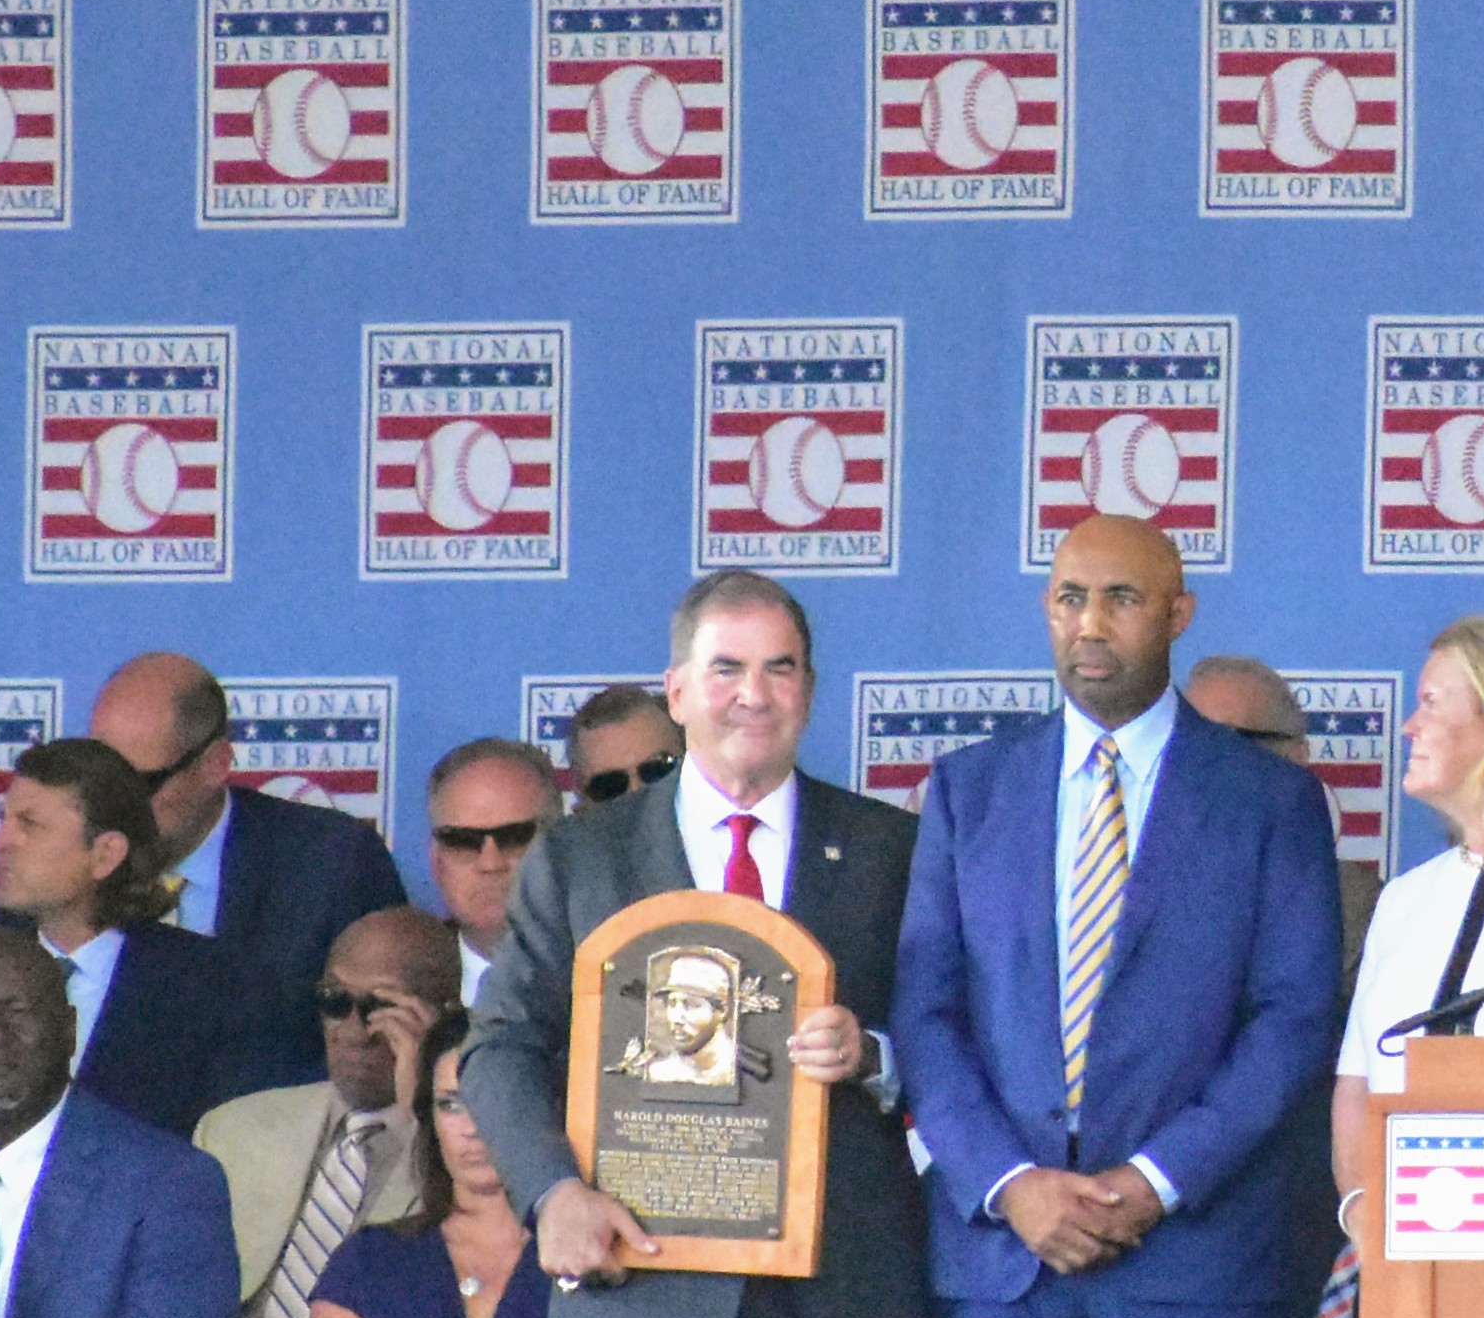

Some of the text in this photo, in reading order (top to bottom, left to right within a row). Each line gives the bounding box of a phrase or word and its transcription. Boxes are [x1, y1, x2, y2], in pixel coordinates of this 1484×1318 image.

[214, 38, 390, 62] BASEBALL
[548, 34, 723, 58] BASEBALL
[882, 27, 1058, 53] BASEBALL
[1218, 28, 1397, 49] BASEBALL
[212, 186, 390, 210] HALL OF FAME
[546, 182, 724, 206] HALL OF FAME
[880, 177, 1057, 201] HALL OF FAME
[1216, 177, 1397, 198] HALL OF FAME
[44, 341, 219, 363] NATIONAL
[378, 337, 553, 361] NATIONAL
[712, 333, 887, 357] NATIONAL
[1043, 330, 1222, 353] NATIONAL
[43, 393, 219, 415] BASEBALL
[378, 389, 553, 413] BASEBALL
[711, 385, 886, 409] BASEBALL
[1042, 383, 1221, 405] BASEBALL
[39, 541, 217, 563] HALL OF FAME
[374, 538, 551, 561] HALL OF FAME
[707, 535, 883, 558] HALL OF FAME
[1378, 533, 1443, 554] HALL
[1449, 533, 1483, 554] OF
[229, 692, 379, 716] ATIONAL
[867, 684, 1043, 710] NATIONAL
[614, 1111, 662, 1123] HAROLD
[666, 1113, 722, 1126] DOUGLAS
[725, 1116, 769, 1128] BAINES
